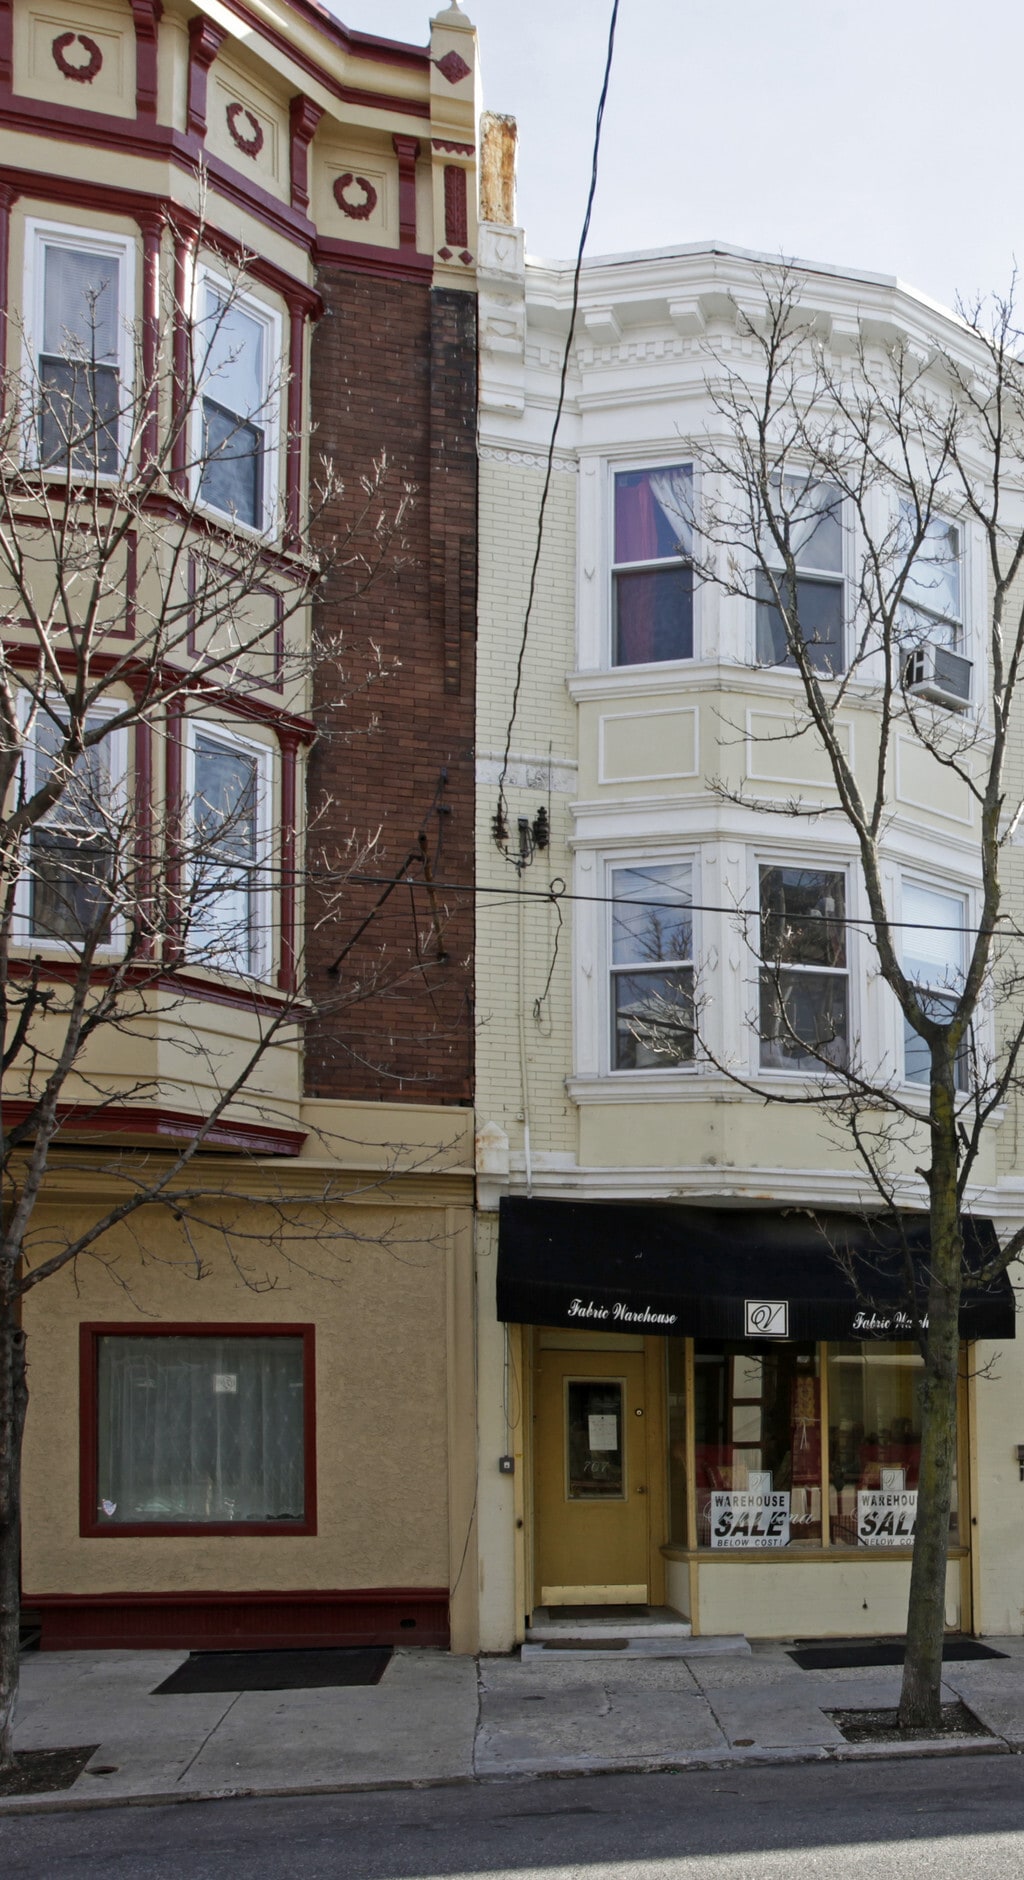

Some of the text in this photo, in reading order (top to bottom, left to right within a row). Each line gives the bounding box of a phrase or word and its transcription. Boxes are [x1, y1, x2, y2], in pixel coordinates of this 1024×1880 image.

[568, 1299, 678, 1325] Fabric Warehouse
[852, 1311, 891, 1330] Fabric
[715, 1495, 785, 1507] WAREHOUSE
[861, 1494, 916, 1506] WAREHOU
[714, 1511, 788, 1537] SALE
[717, 1539, 783, 1547] BELOW COST!
